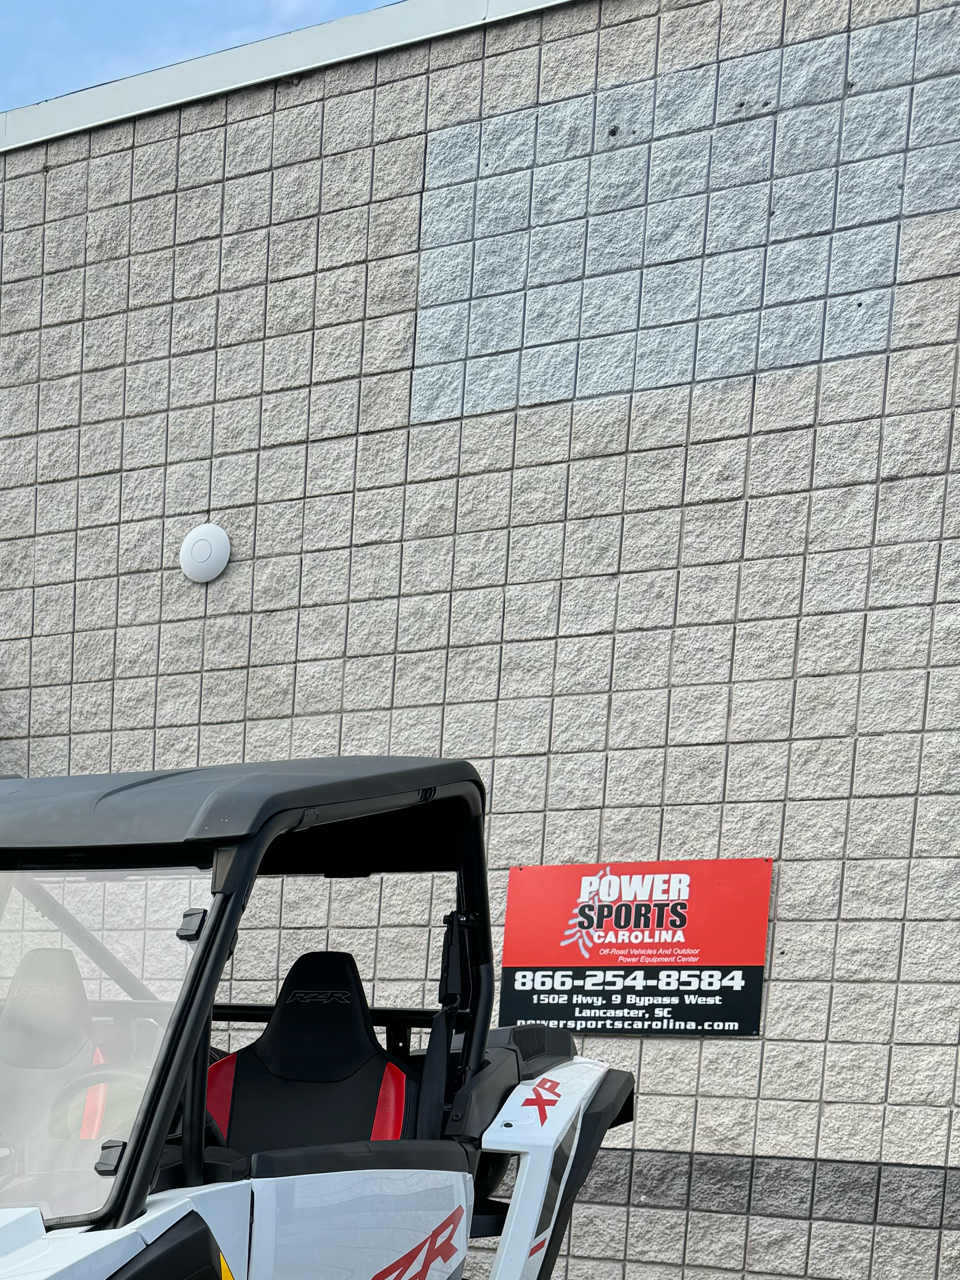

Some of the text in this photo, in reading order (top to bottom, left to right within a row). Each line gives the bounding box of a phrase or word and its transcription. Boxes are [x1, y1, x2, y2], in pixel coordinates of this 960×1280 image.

[580, 873, 690, 901] POWER
[577, 901, 688, 930] SPORTS
[593, 930, 685, 944] CAROLINA
[673, 947, 700, 955] Outdoor
[640, 956, 675, 964] Equipment
[514, 970, 745, 991] 866-254-8584
[286, 990, 351, 1004] RZR
[532, 994, 722, 1006] 1502 Hwy. 9 Bypass West
[575, 1007, 672, 1019] Lancaster, SC
[521, 1077, 562, 1127] XP
